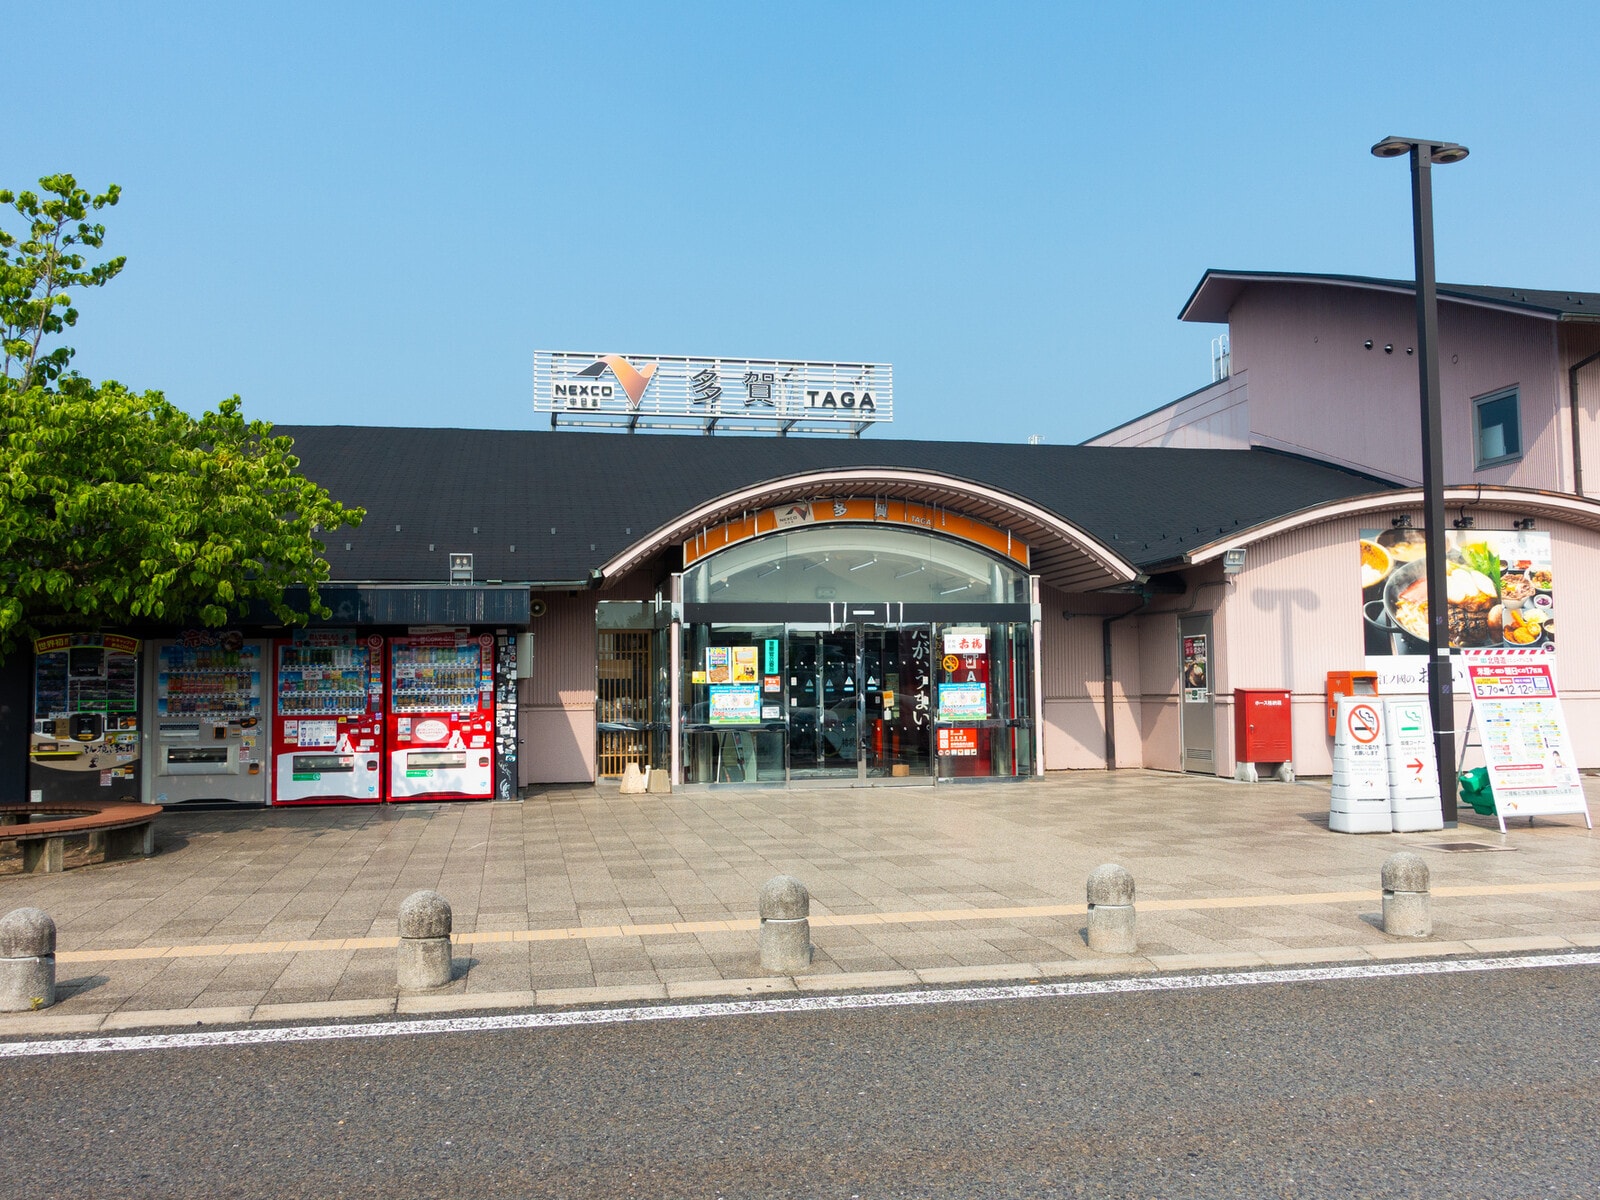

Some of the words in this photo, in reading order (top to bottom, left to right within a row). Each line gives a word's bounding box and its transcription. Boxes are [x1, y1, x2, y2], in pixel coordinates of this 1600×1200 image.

[555, 384, 613, 397] NEXCO
[807, 391, 875, 409] TAGA
[911, 515, 931, 526] TAGA
